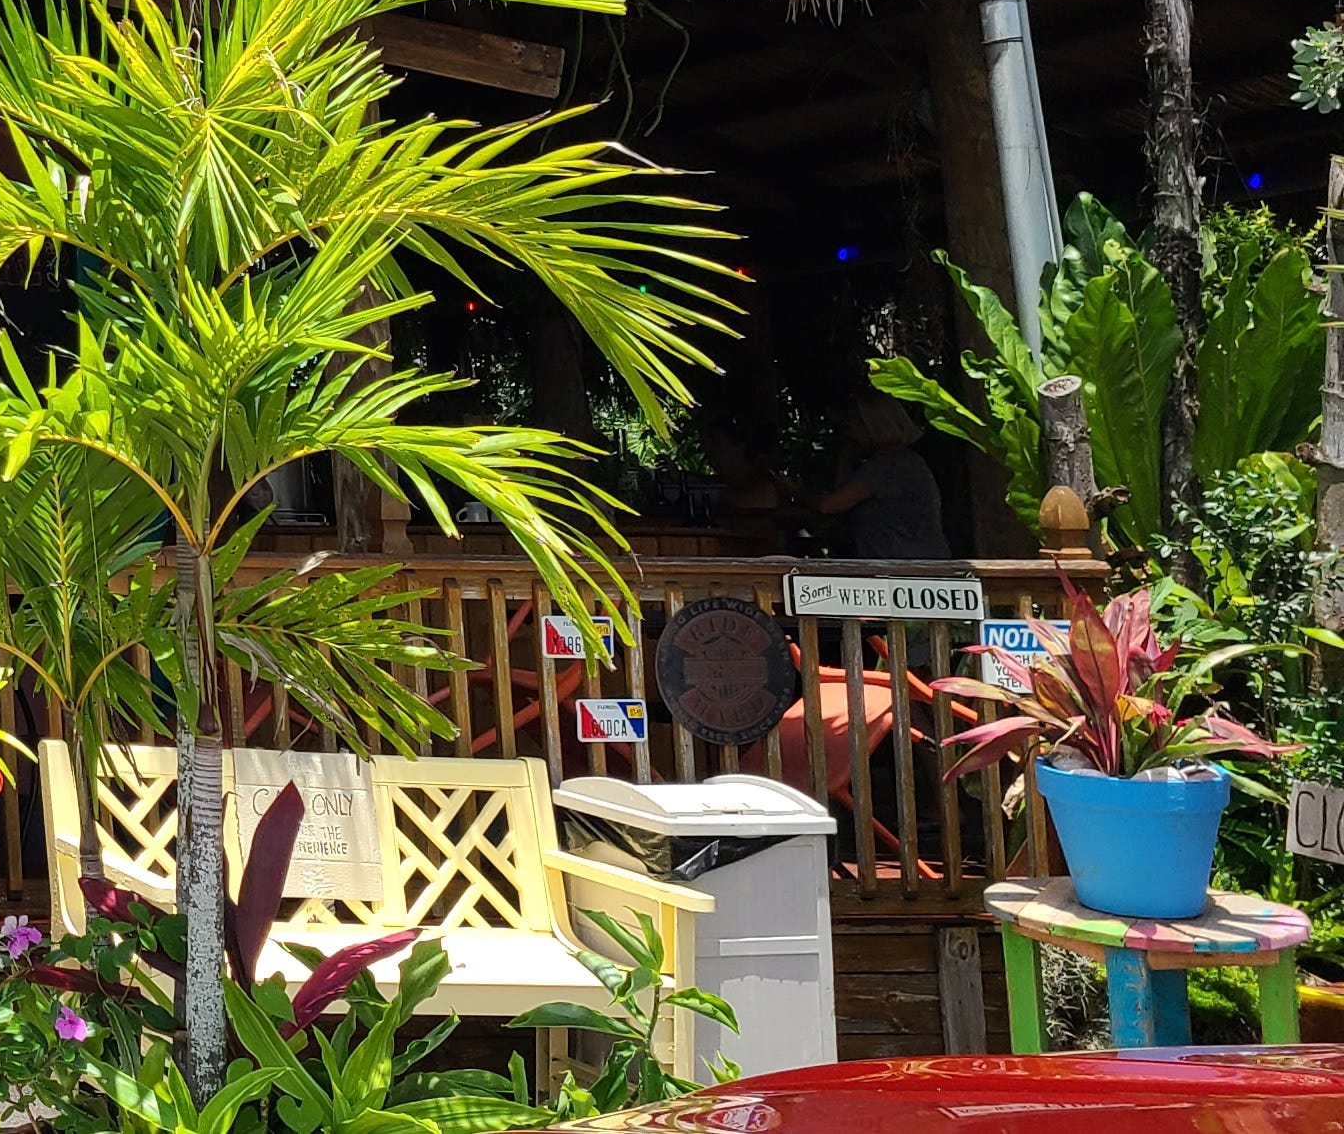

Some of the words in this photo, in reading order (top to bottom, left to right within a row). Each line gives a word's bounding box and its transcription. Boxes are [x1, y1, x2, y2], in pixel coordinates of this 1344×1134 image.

[799, 584, 832, 602] Sorry
[838, 588, 887, 607] WE'RE
[892, 586, 979, 611] CLOSED
[988, 627, 1039, 648] NOTI
[991, 654, 1030, 664] WCH
[998, 678, 1022, 688] STE
[311, 792, 354, 817] ONLY
[320, 826, 343, 840] THE
